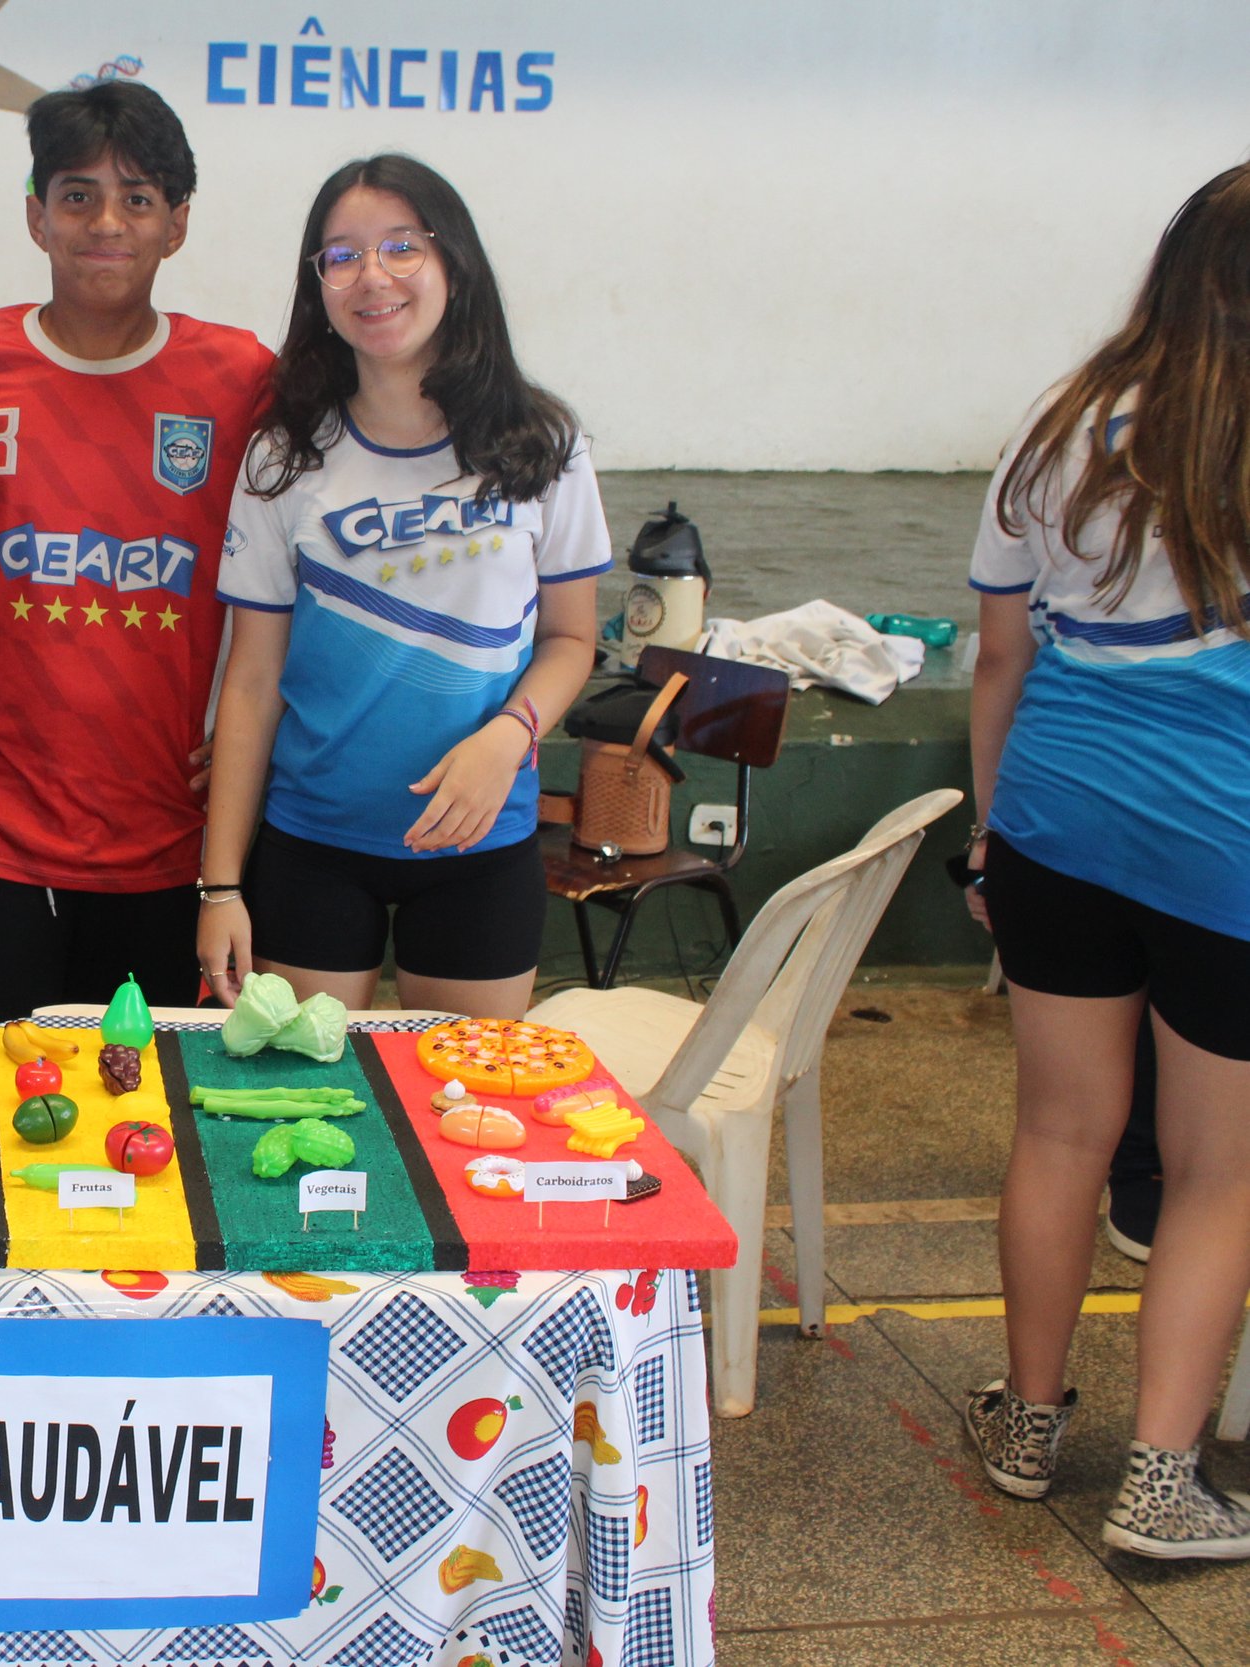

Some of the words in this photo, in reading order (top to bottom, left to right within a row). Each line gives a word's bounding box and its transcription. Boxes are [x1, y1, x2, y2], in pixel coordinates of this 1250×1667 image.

[206, 16, 555, 112] CIÊNCIAS
[1, 532, 194, 585] CEART
[536, 1175, 613, 1187] Carboidratos
[71, 1183, 113, 1193] Frutas
[307, 1184, 357, 1196] Vegetais
